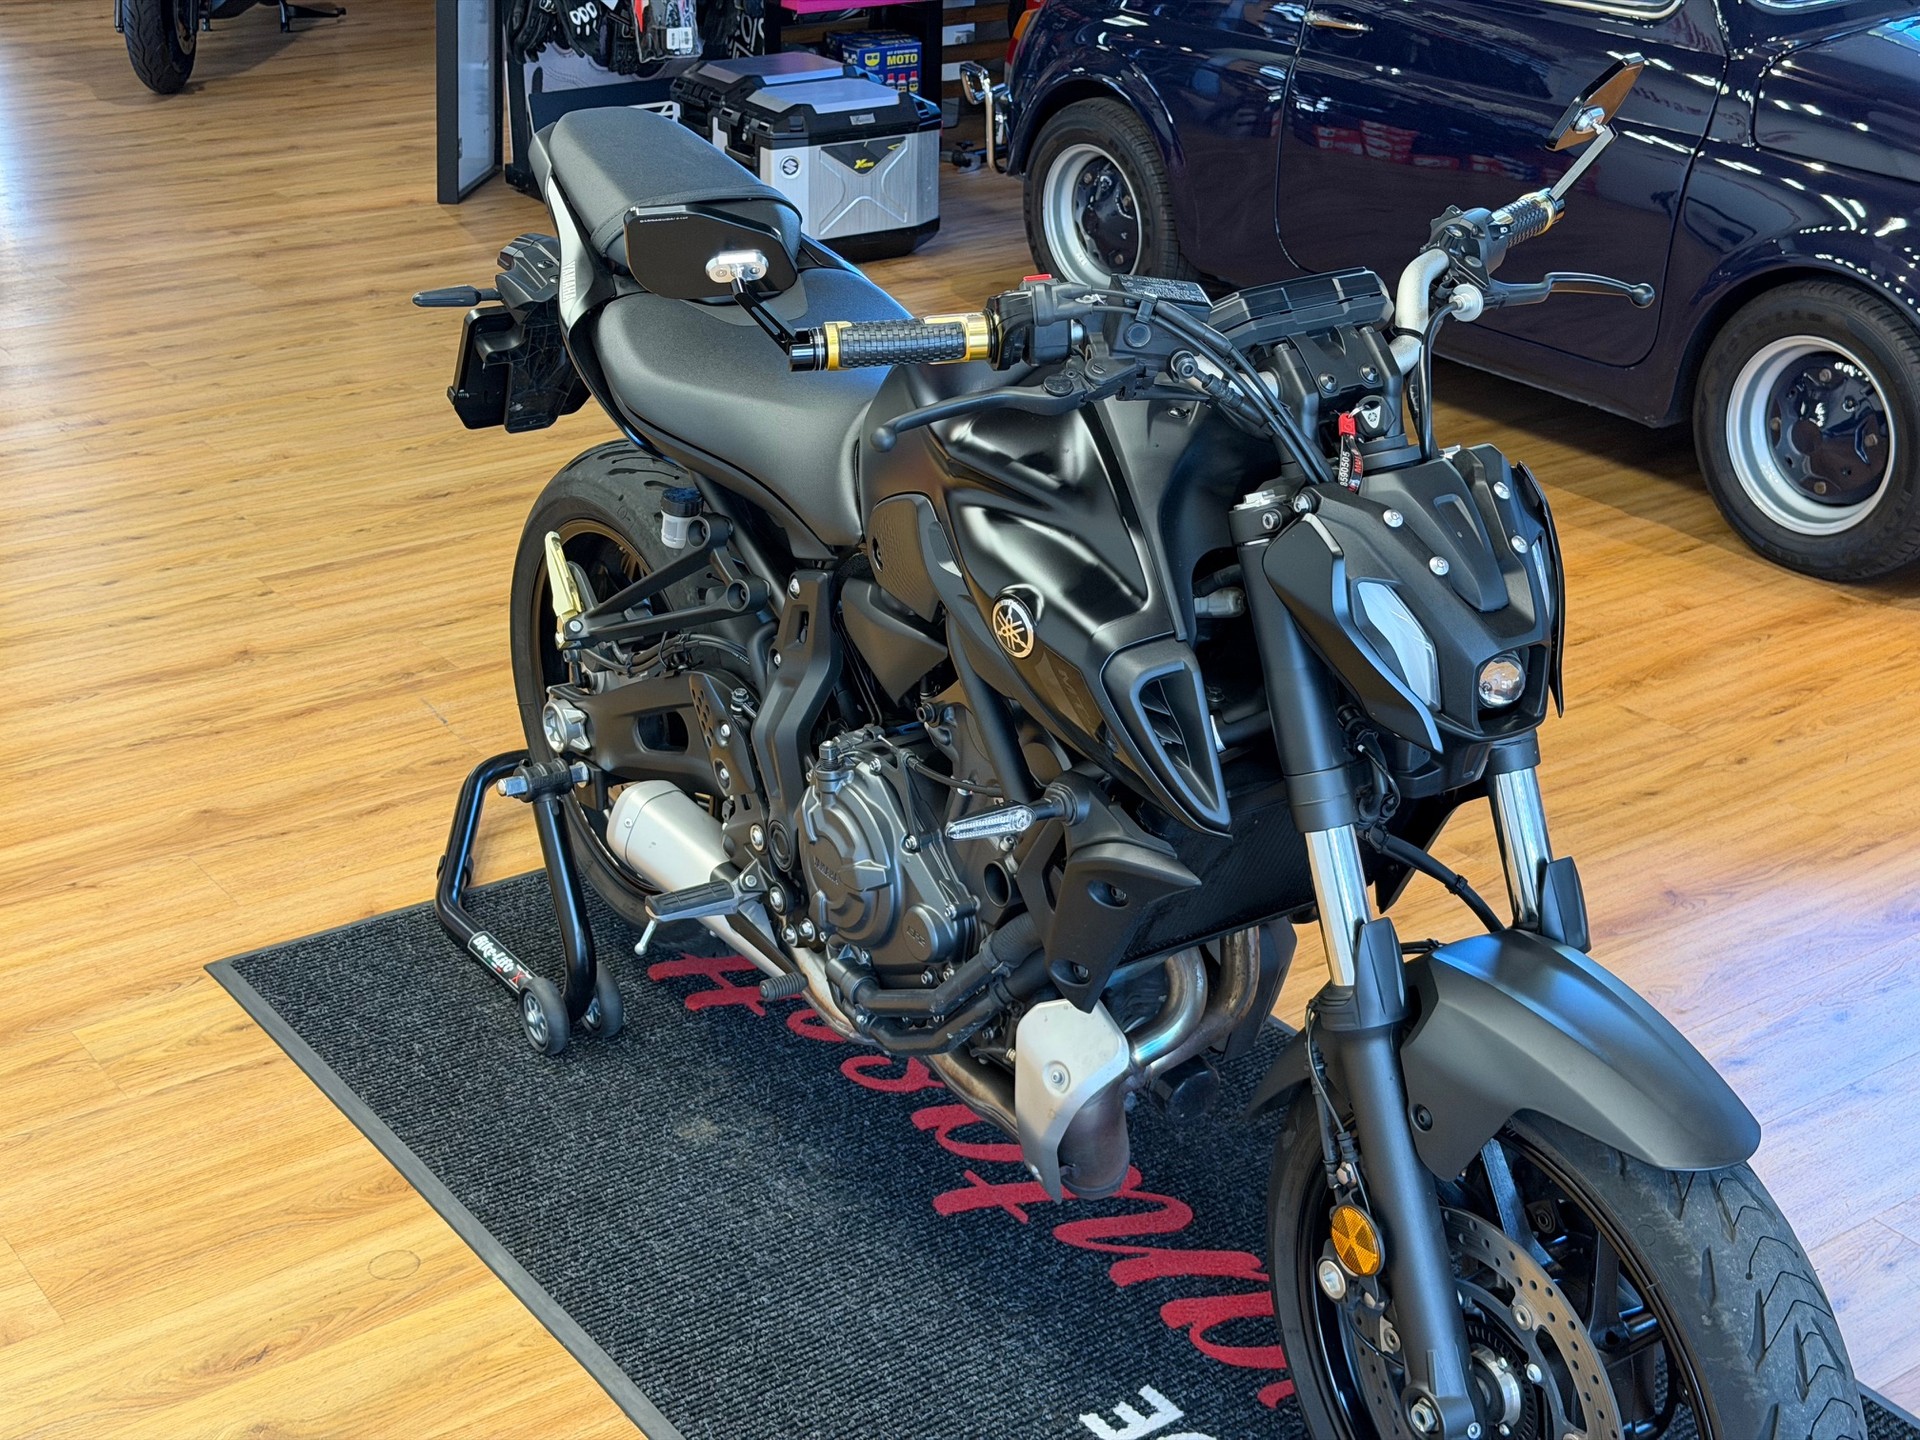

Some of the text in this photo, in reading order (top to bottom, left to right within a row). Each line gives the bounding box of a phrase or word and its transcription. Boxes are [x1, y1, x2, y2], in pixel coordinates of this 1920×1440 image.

[886, 53, 918, 66] MOTO
[562, 260, 576, 303] YAMAHA
[1340, 451, 1351, 487] 8590505
[473, 934, 515, 973] Bike-Lift
